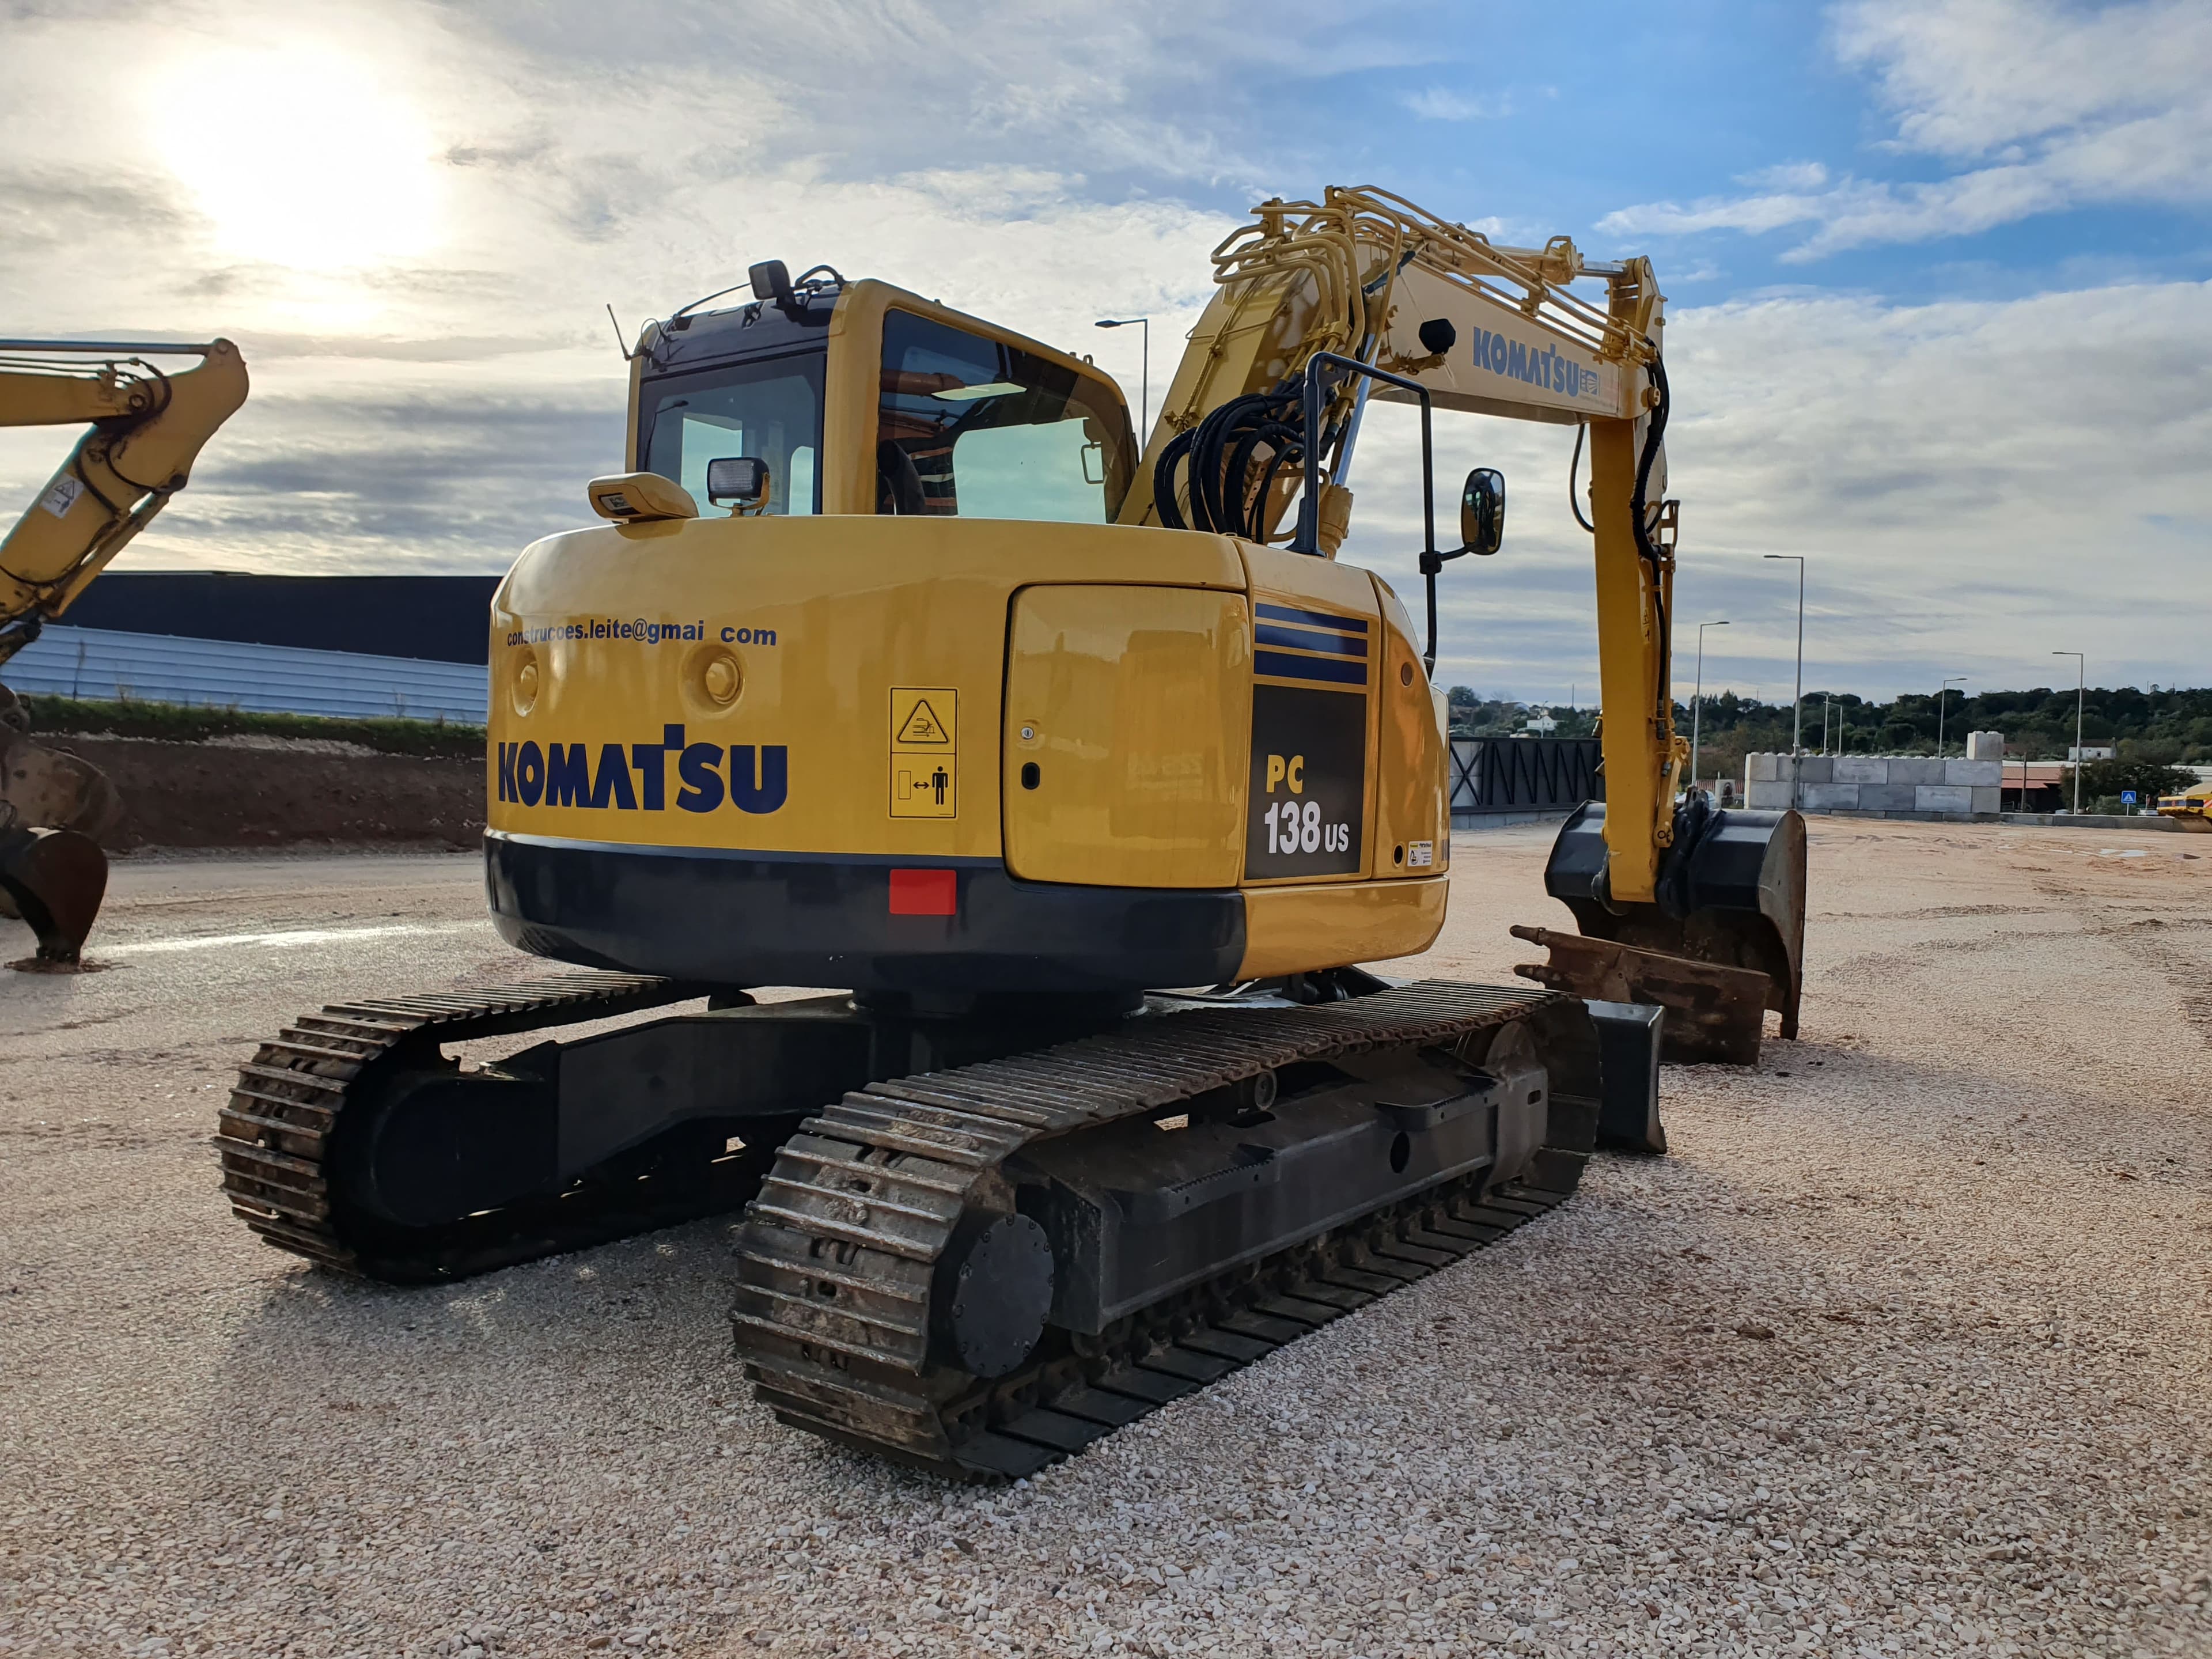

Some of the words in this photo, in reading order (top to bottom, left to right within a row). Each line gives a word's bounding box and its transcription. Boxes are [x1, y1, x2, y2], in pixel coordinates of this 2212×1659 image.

[1473, 325, 1580, 397] KOMATSU
[721, 626, 777, 646] com
[498, 724, 788, 814] KOMATSU
[1266, 755, 1304, 794] PC
[1264, 801, 1321, 854] 138
[1325, 823, 1349, 853] US
